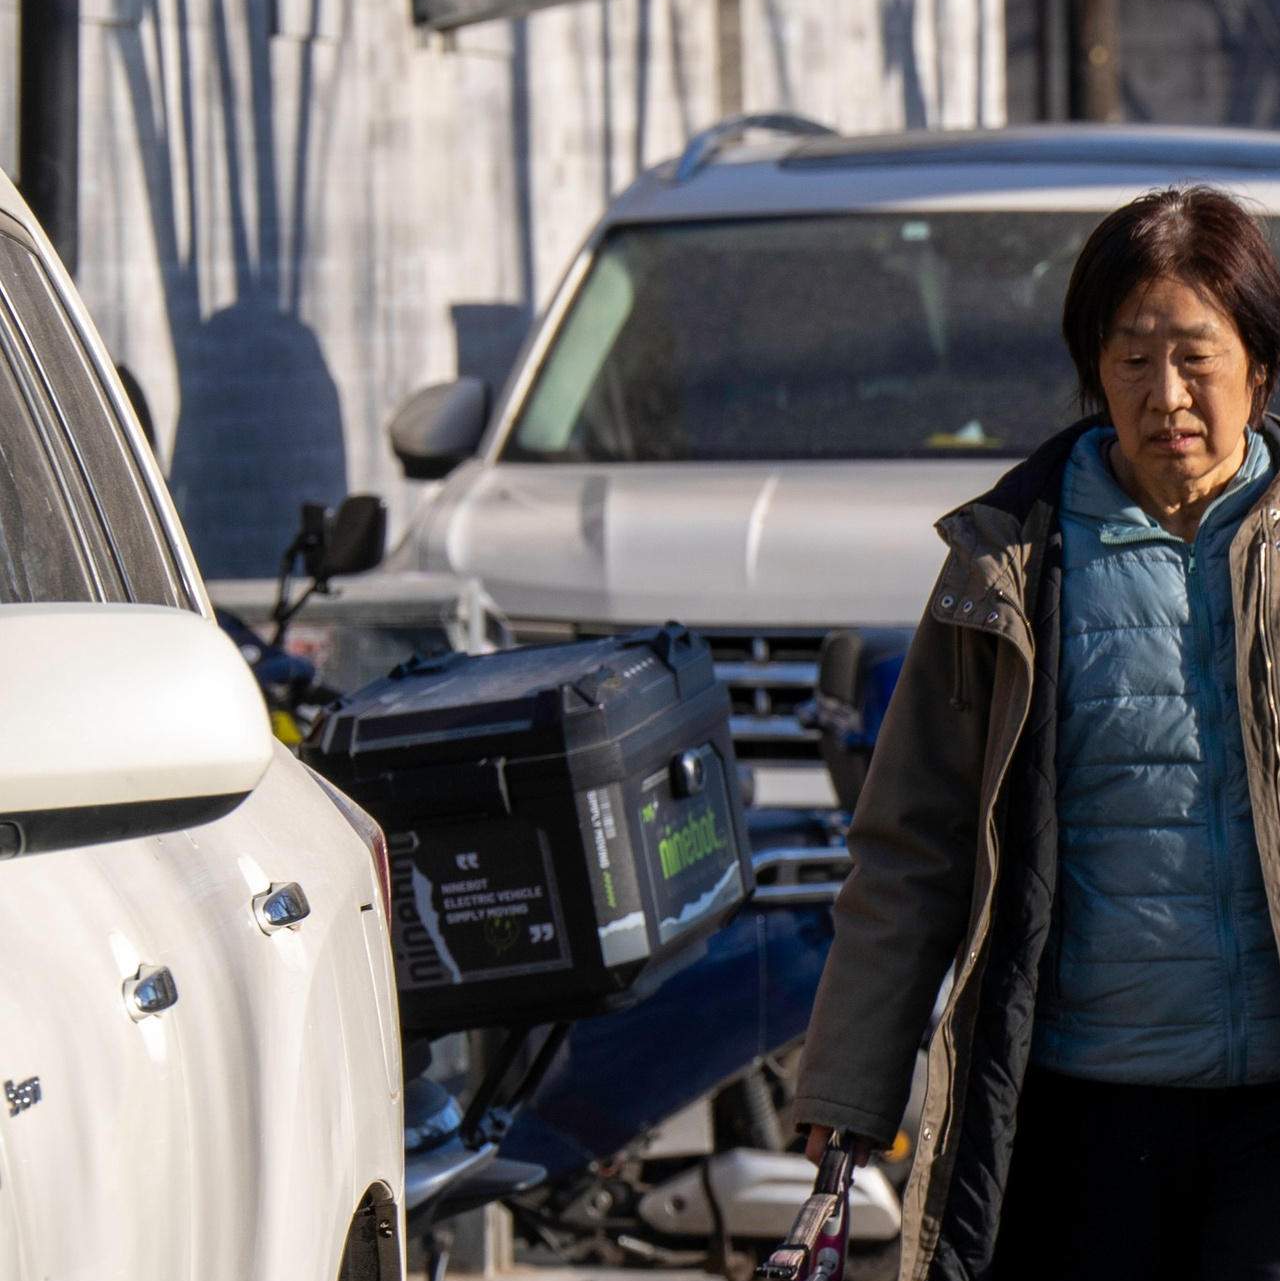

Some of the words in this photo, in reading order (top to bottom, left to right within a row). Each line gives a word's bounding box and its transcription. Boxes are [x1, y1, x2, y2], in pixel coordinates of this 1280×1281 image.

[659, 804, 722, 881] ninebot
[440, 877, 488, 895] NINEBOT
[443, 892, 495, 910] ELECTRIC
[496, 885, 543, 902] VEHICLE
[445, 909, 485, 925] SIMPLY
[486, 903, 529, 919] MOVING
